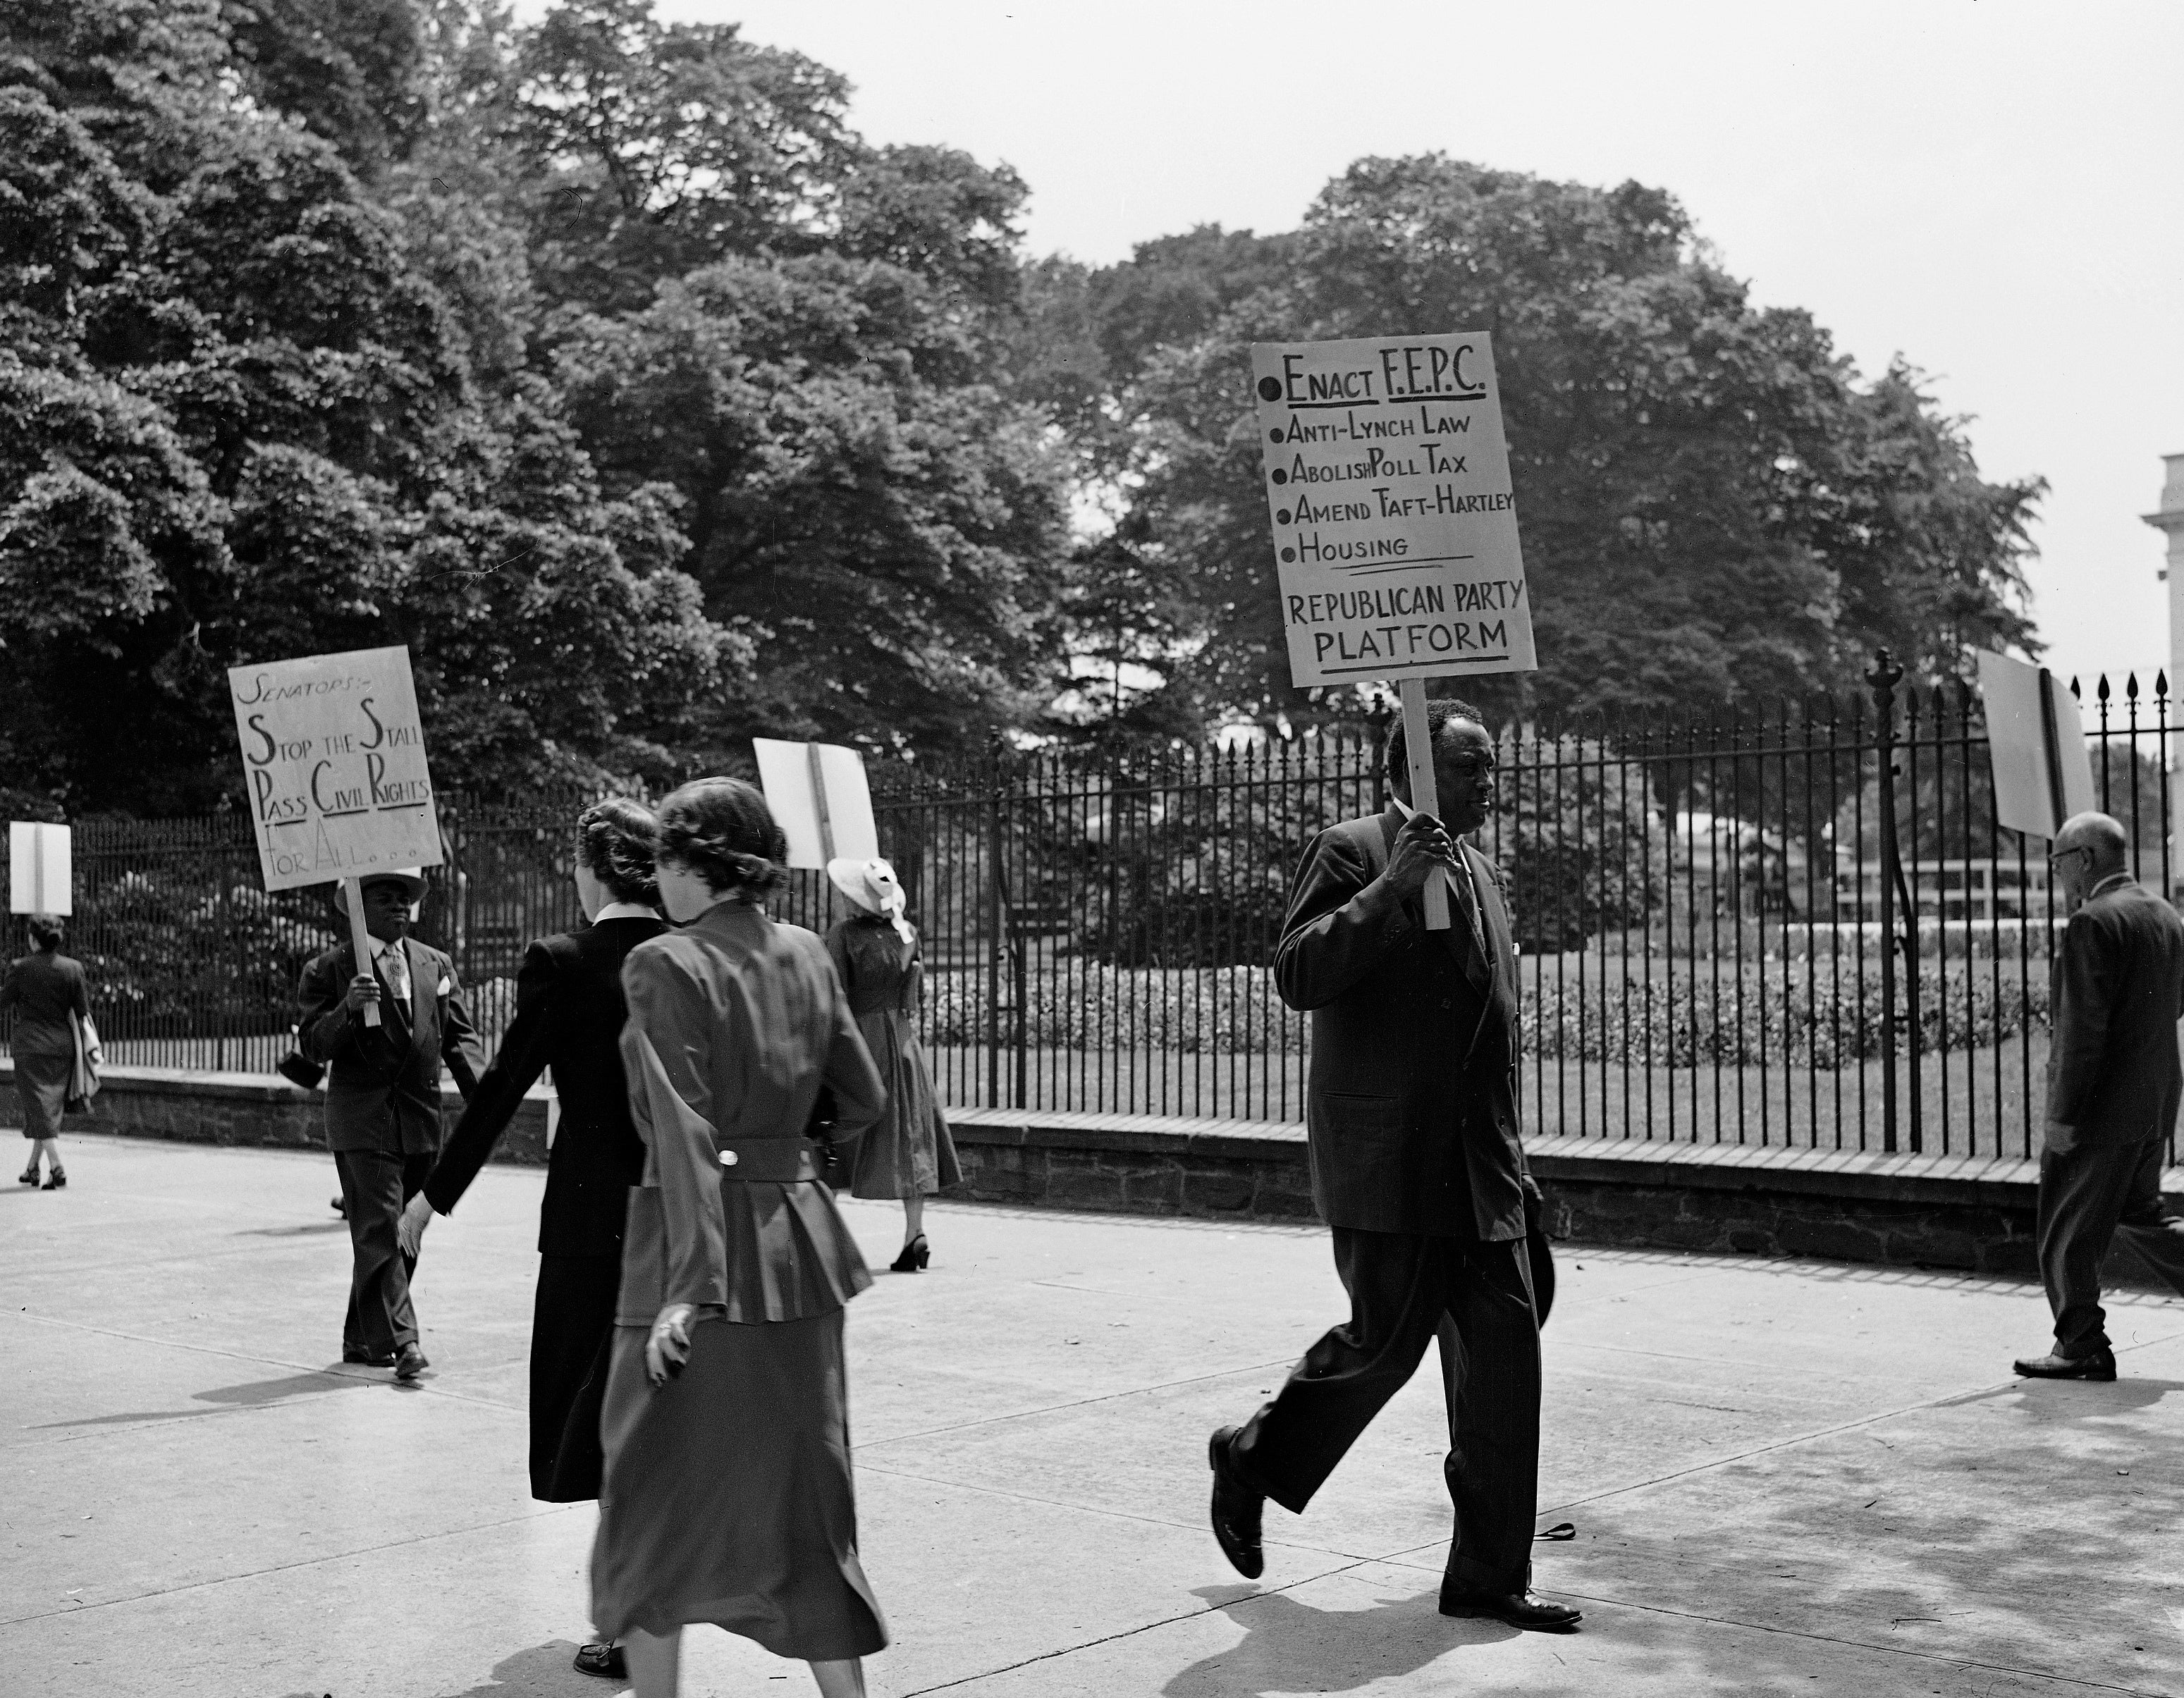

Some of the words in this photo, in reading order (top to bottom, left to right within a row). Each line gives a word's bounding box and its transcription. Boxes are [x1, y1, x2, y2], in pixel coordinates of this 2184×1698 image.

[1283, 355, 1373, 401] ENACT
[1379, 345, 1485, 395] F.E.P.C.
[1287, 410, 1413, 443] ANTI-LYNCH
[1421, 405, 1471, 433] LAW
[1291, 453, 1371, 483] ABOLISH
[1366, 448, 1421, 477] POLL
[1419, 443, 1468, 474] TAX
[1294, 494, 1370, 524] AMEND
[1371, 484, 1514, 517] TAFT-HARTLEY
[1299, 532, 1409, 562] HOUSING
[1287, 585, 1444, 625] REPUBLICAN
[1453, 579, 1523, 614] PARTY
[1315, 620, 1507, 662] PLATFORM
[247, 714, 312, 765] STOP
[323, 733, 355, 756] THE
[360, 698, 421, 749] STALL
[253, 769, 307, 821] PASS
[311, 760, 369, 811] CIVIL
[365, 753, 429, 804] RIGHTS
[264, 824, 309, 876] FOR
